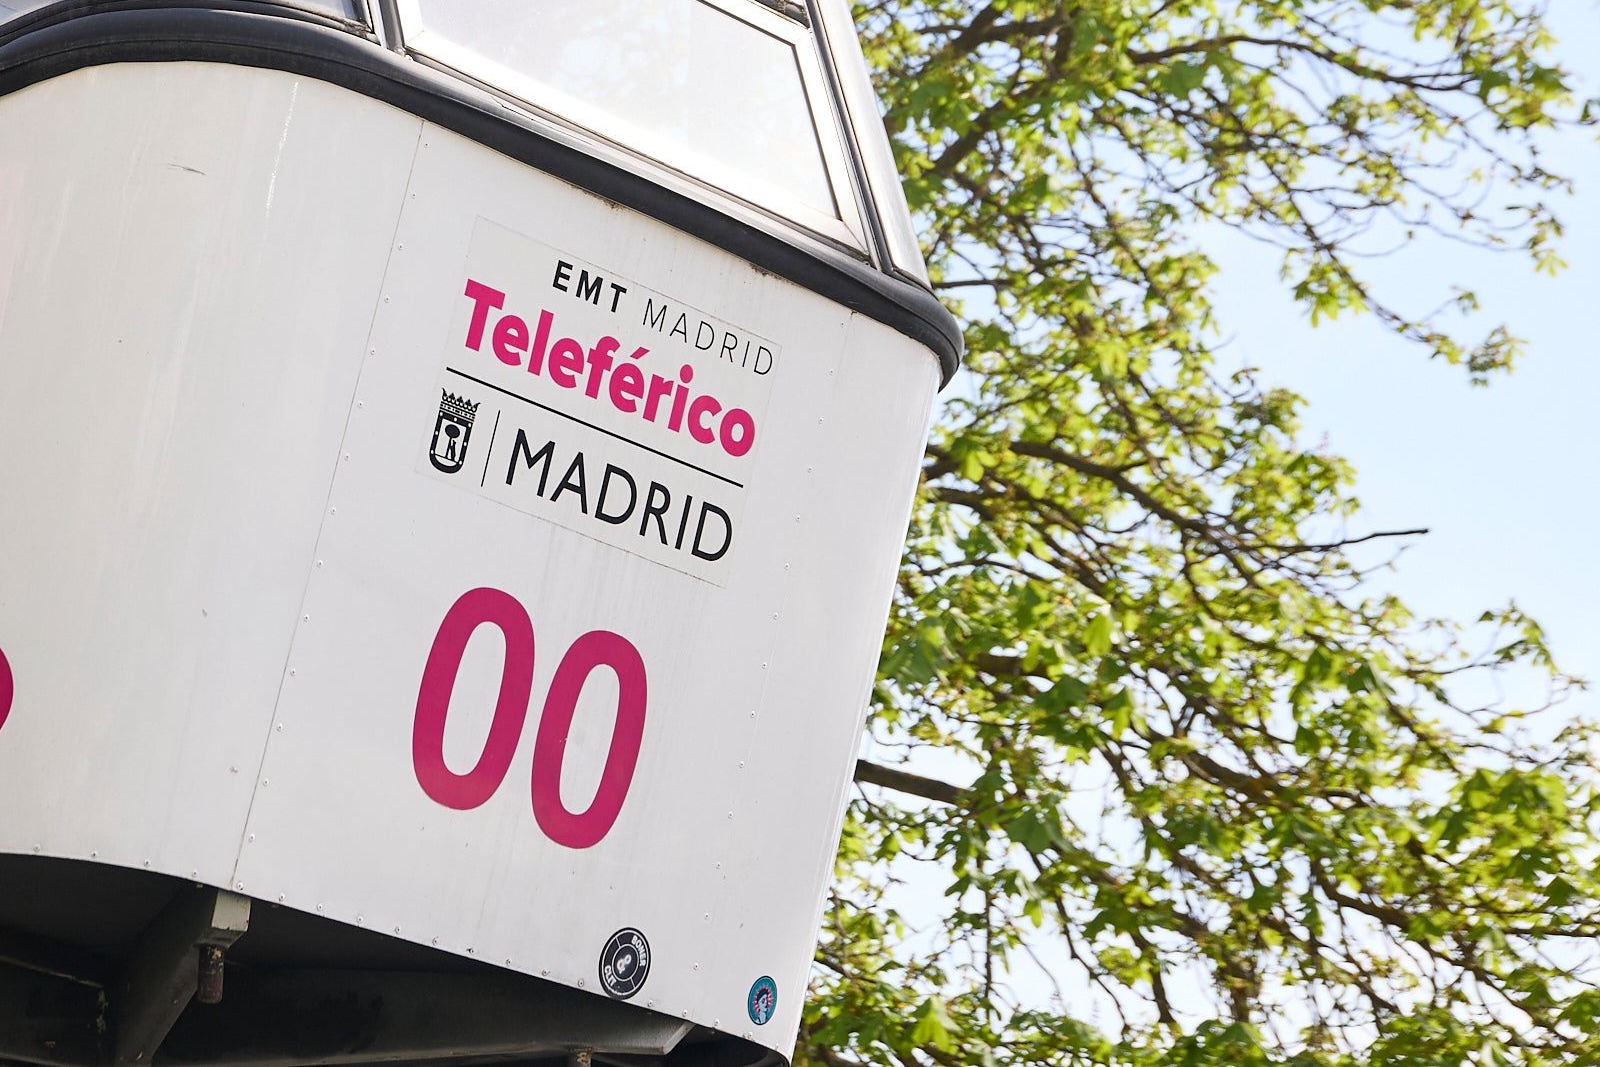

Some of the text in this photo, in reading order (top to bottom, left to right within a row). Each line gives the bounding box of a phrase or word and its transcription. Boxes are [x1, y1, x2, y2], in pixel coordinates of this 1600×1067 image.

[464, 278, 756, 457] Teleférico
[552, 260, 774, 376] EMT MADRID
[505, 428, 733, 562] MADRID
[412, 586, 648, 850] 00
[631, 935, 647, 967] BONER
